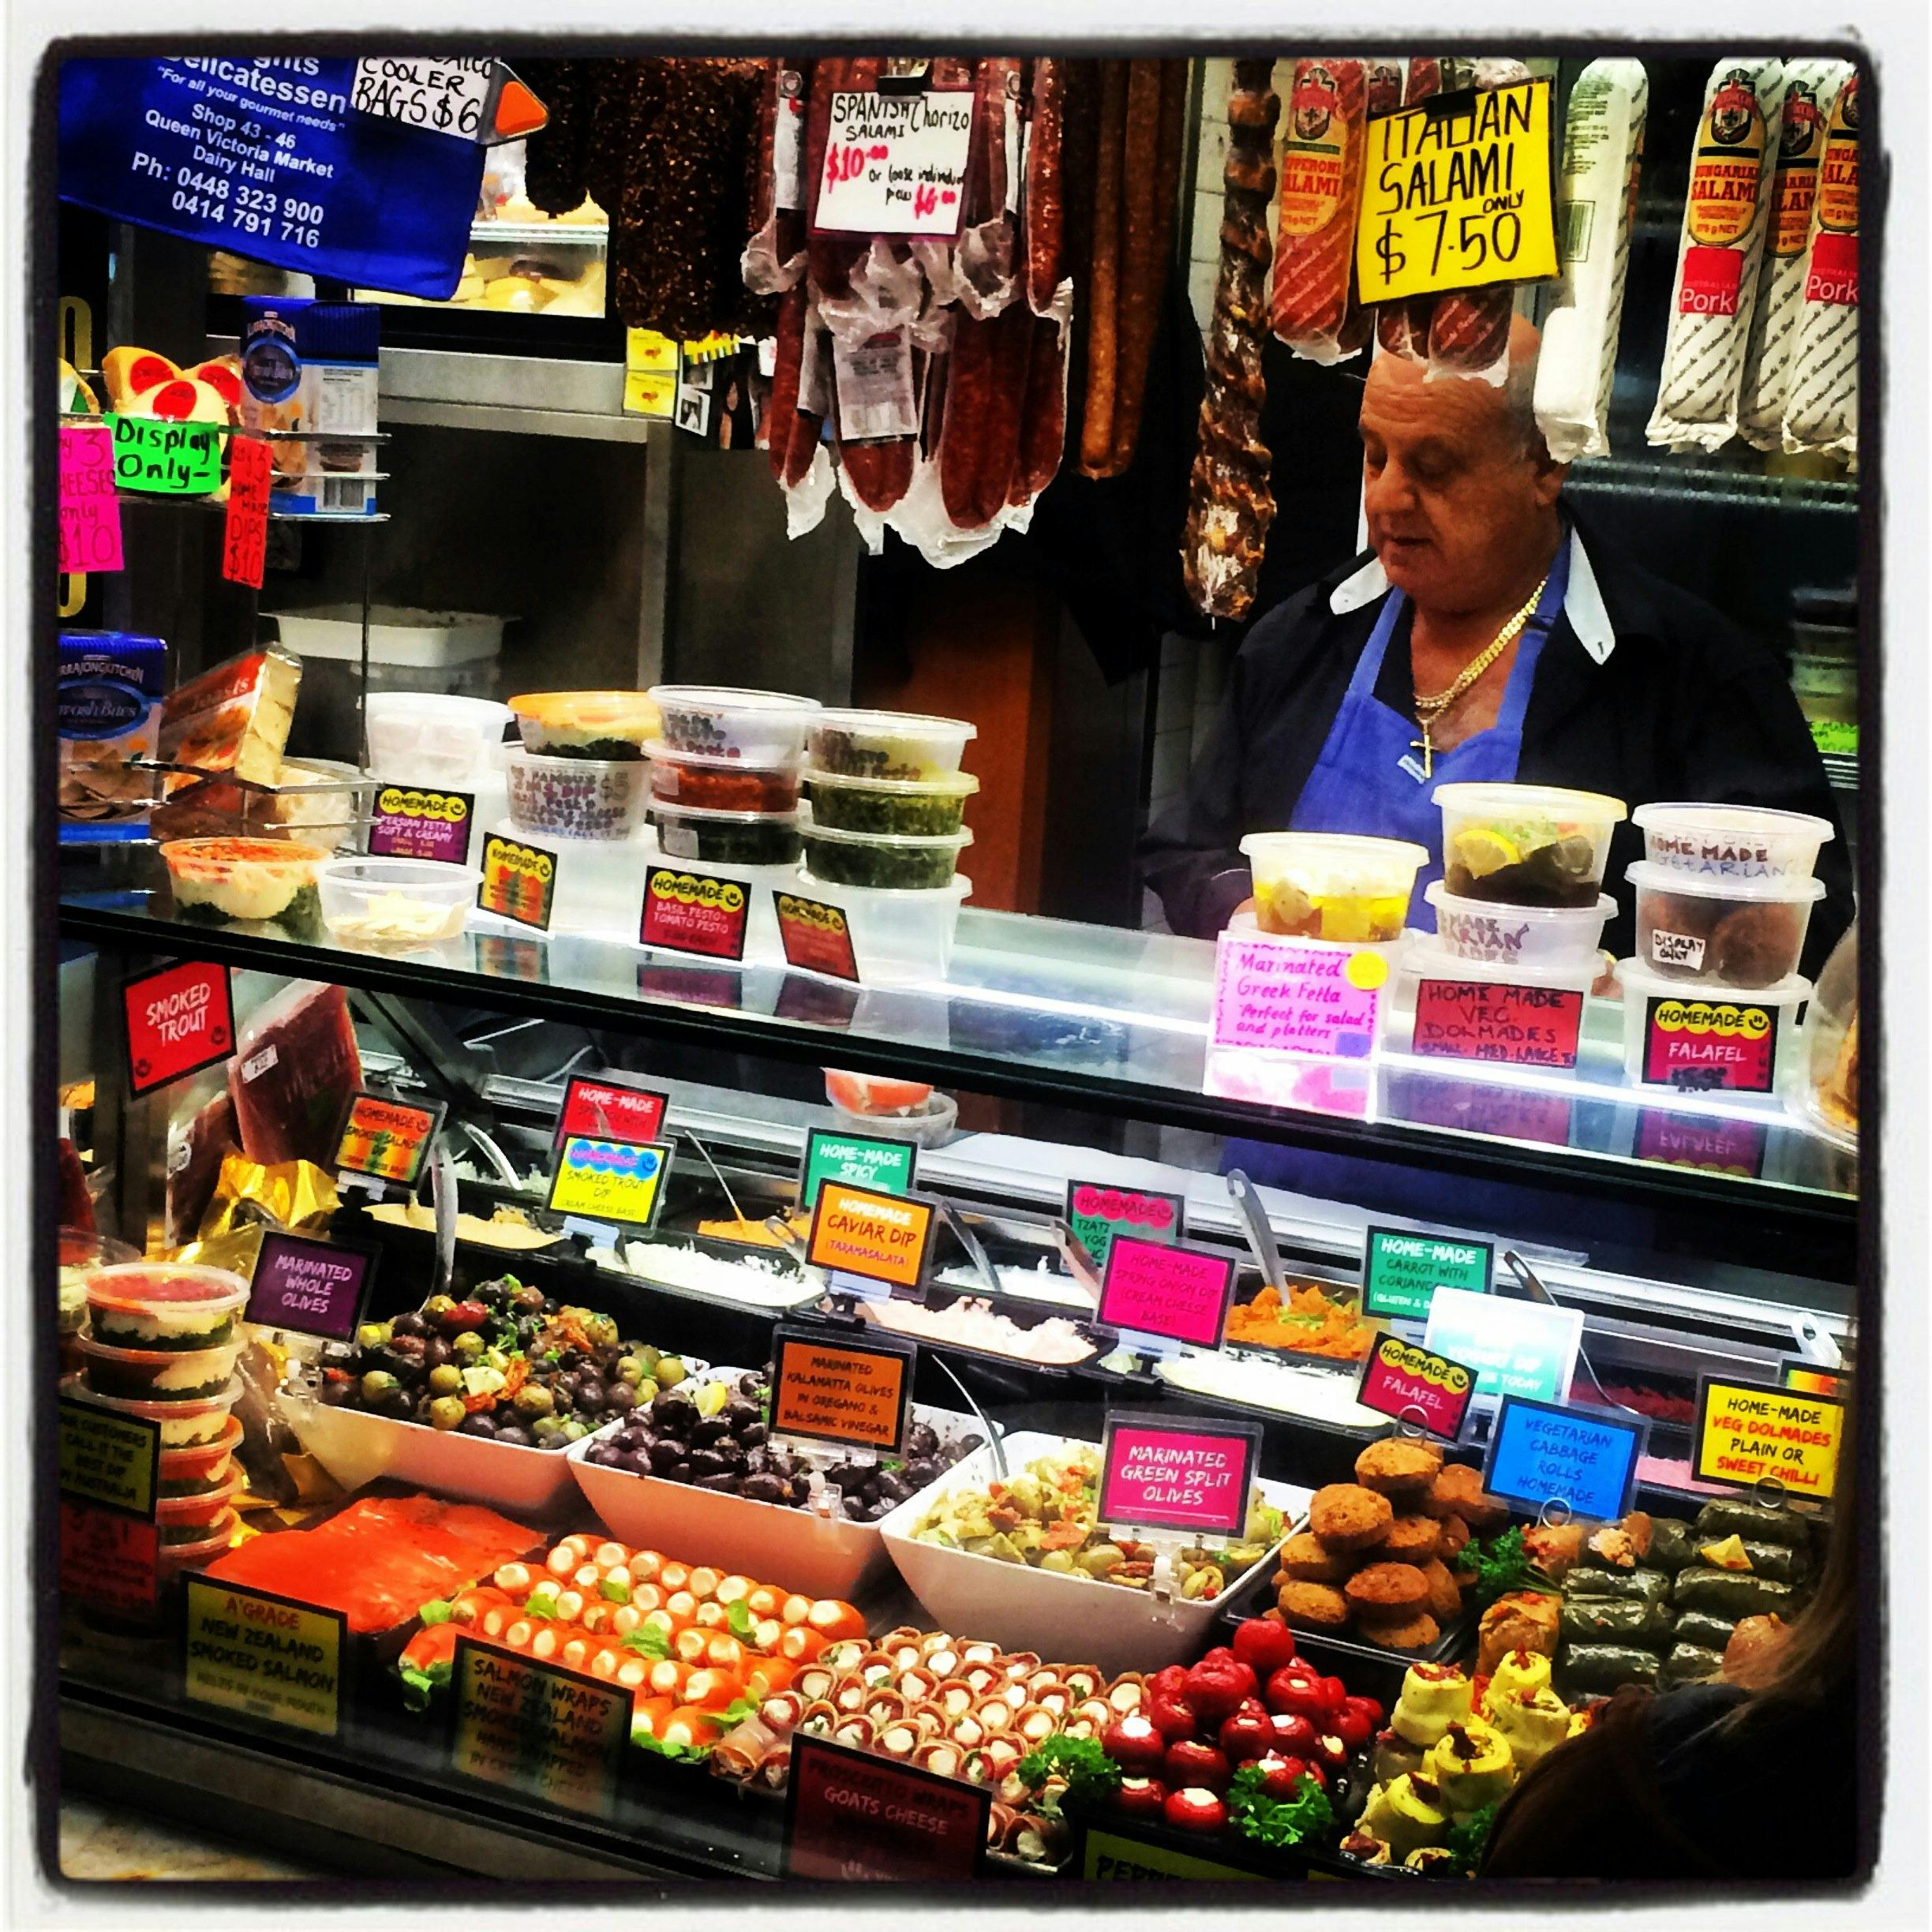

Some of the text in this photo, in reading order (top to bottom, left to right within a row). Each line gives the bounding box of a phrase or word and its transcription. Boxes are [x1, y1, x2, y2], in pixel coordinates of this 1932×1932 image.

[362, 57, 464, 96] COOLER
[188, 79, 205, 91] all
[207, 85, 238, 102] your
[240, 97, 294, 123] gourmet
[356, 77, 480, 133] BAGS $6
[911, 95, 969, 132] Chorizo
[192, 103, 296, 148] Shop 43 46
[846, 125, 904, 140] SALAMI
[145, 110, 334, 178] Queen Victoria Market
[193, 146, 275, 182] Dairy Hall
[131, 152, 324, 225] Ph: 0448 323 900
[1376, 142, 1515, 216] SALAMI
[1482, 189, 1525, 213] ONLY
[172, 191, 320, 248] 0414 791 716
[1679, 288, 1735, 313] Pork
[1807, 275, 1859, 301] Pork
[77, 429, 106, 467] 3
[114, 417, 212, 465] Display
[383, 795, 448, 812] HOMEMADE
[378, 826, 452, 843] SOFT CREAMY
[424, 821, 452, 831] FETTA
[492, 848, 538, 870] HOMEMADE
[1702, 845, 1768, 862] MADE
[653, 876, 724, 900] HOMEMADE
[657, 901, 687, 915] BASIL
[653, 912, 728, 934] TOMATO PESTO
[1655, 934, 1703, 952] DISPLAY
[1660, 949, 1687, 960] ONLY
[1239, 953, 1342, 977] Marinated
[1237, 975, 1341, 1003] Greek Fetta
[1428, 985, 1565, 1008] HOME MADE
[146, 983, 211, 1026] SMOKED
[1299, 1009, 1319, 1023] for
[1326, 1010, 1365, 1025] salad
[157, 1005, 209, 1047] TROUT
[1237, 1023, 1267, 1034] and
[1658, 1009, 1746, 1028] HOMEMADE
[1668, 1042, 1747, 1061] FALAFEL
[578, 1088, 654, 1114] HOME-MADE
[356, 1105, 416, 1128] HOMEMADE
[820, 1143, 903, 1166] HOME-MADE
[567, 1171, 644, 1189] SMOKED TROUT
[840, 1163, 879, 1179] SPICY
[593, 1187, 612, 1198] DIP
[839, 1198, 912, 1225] HOMEMADE
[1080, 1196, 1155, 1216] HOMEMADE
[828, 1214, 917, 1248] CAVIAR DIP
[1381, 1238, 1477, 1264] HOME-MADE
[275, 1255, 353, 1282] MARINATED
[1132, 1255, 1208, 1279] HOME-MADE
[1386, 1258, 1468, 1281] CARROT WITH
[285, 1275, 335, 1296] WHOLE
[1116, 1269, 1218, 1297] SPRING ONION DIP
[281, 1292, 330, 1314] OLIVES
[1165, 1297, 1208, 1316] CHEESE
[811, 1357, 874, 1376] MARINATED
[1382, 1345, 1451, 1380] HOMEMADE
[787, 1372, 893, 1398] KALAMATTA OLIVES
[1383, 1376, 1443, 1410] FALAFEL
[1502, 1374, 1541, 1391] TODAY
[797, 1393, 878, 1415] IN OREGANO &
[1728, 1398, 1822, 1425] HOME-MADE
[784, 1410, 889, 1436] BALSAMIC VINEGAR
[1525, 1419, 1612, 1449] VEGETARIAN
[1713, 1416, 1832, 1447] VEG DOLMADES
[1129, 1446, 1227, 1468] MARINATED
[1530, 1440, 1599, 1465] CABBAGE
[1731, 1438, 1804, 1466] PLAIN OR
[1121, 1464, 1232, 1488] GREEN SPLIT
[1538, 1461, 1583, 1481] ROLLS
[1717, 1456, 1820, 1485] SWEET CHILLI
[1143, 1485, 1204, 1506] OLIVES
[1517, 1476, 1596, 1503] HOMEMADE
[201, 1617, 324, 1662] NEW ZEALAND
[190, 1640, 335, 1693] SMOKED SALMON
[474, 1659, 612, 1717] SALMON WRAPS
[476, 1682, 602, 1736] NEW ZEALAND
[824, 1785, 949, 1835] GOATS CHEESE
[913, 1791, 970, 1818] WRAPS
